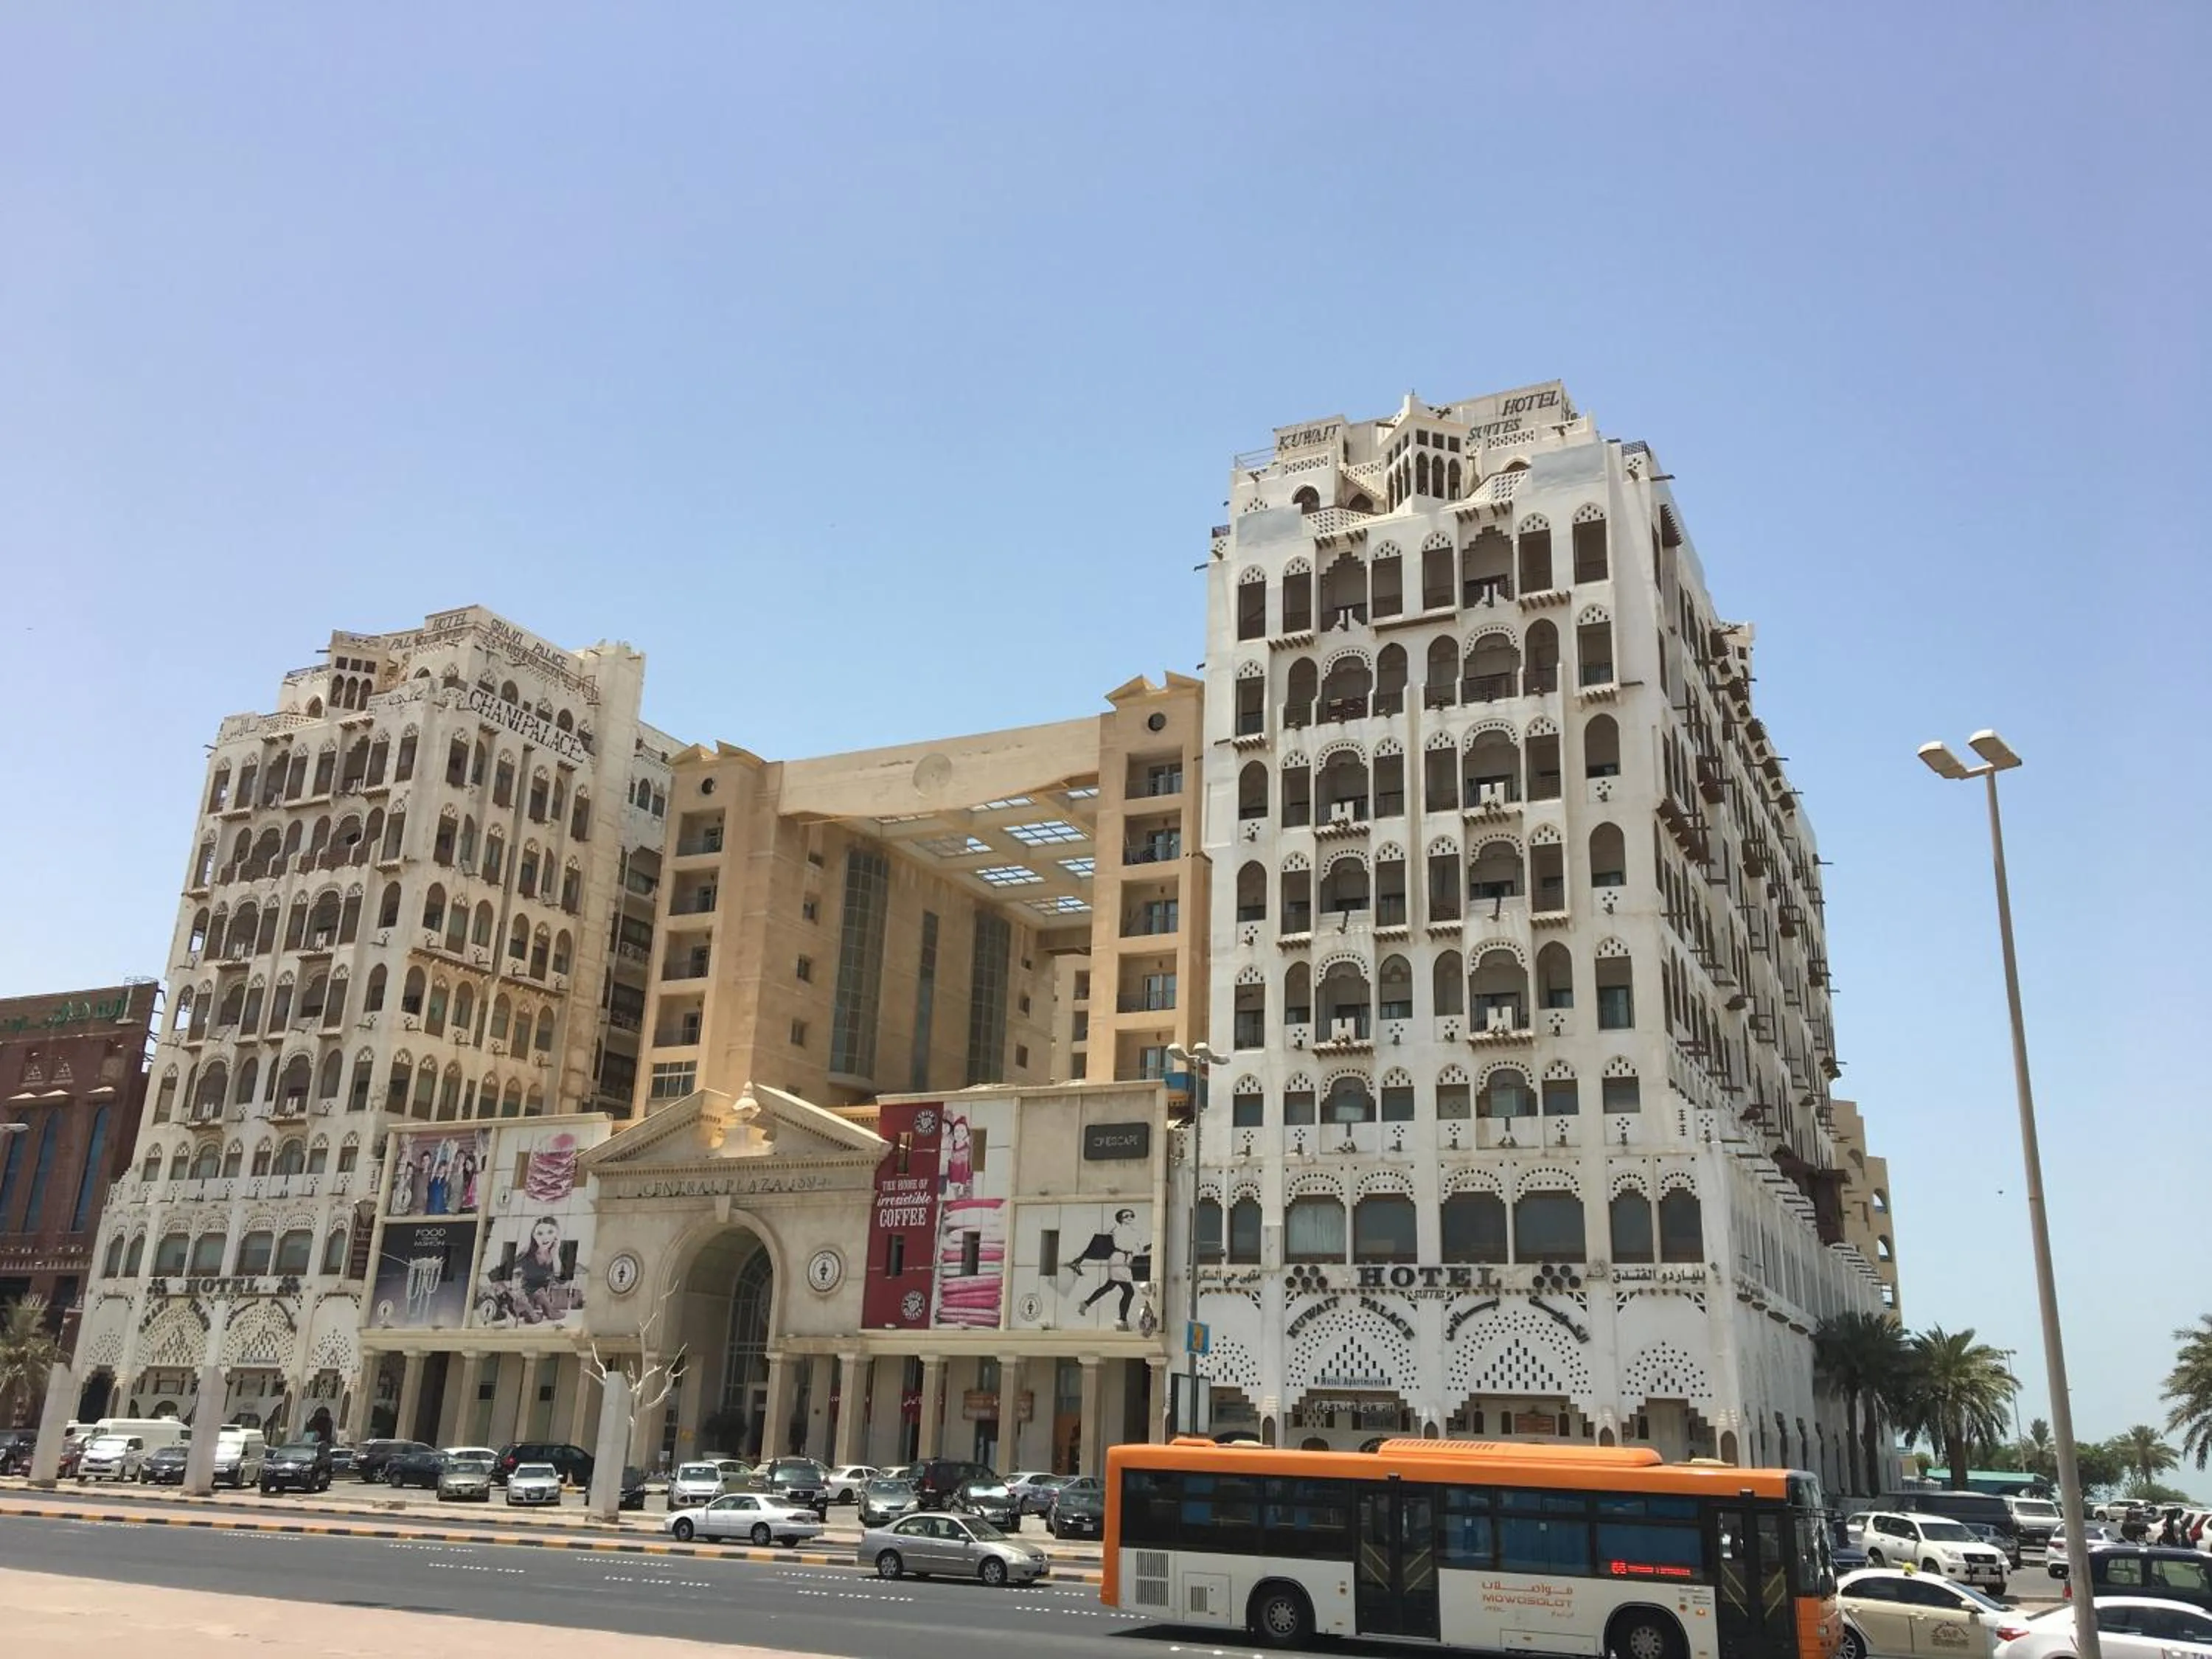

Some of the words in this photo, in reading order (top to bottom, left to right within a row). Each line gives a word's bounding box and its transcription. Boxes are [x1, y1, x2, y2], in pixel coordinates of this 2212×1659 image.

[1502, 390, 1559, 417] HOTEL
[1278, 424, 1341, 451] KUWAIT
[1467, 418, 1522, 440] SUITES
[519, 714, 585, 764] PALACE
[644, 1180, 719, 1196] CENTRAL
[725, 1178, 782, 1194] PLAZA
[882, 1180, 895, 1191] THE
[918, 1178, 928, 1189] OF
[877, 1191, 932, 1207] irresistible
[880, 1207, 926, 1228] COFFEE
[415, 1228, 446, 1237] FOOD
[184, 1277, 260, 1294] HOTEL
[1357, 1267, 1502, 1288] HOTEL
[1286, 1295, 1340, 1339] KUWAIT
[1359, 1295, 1416, 1341] PALACE
